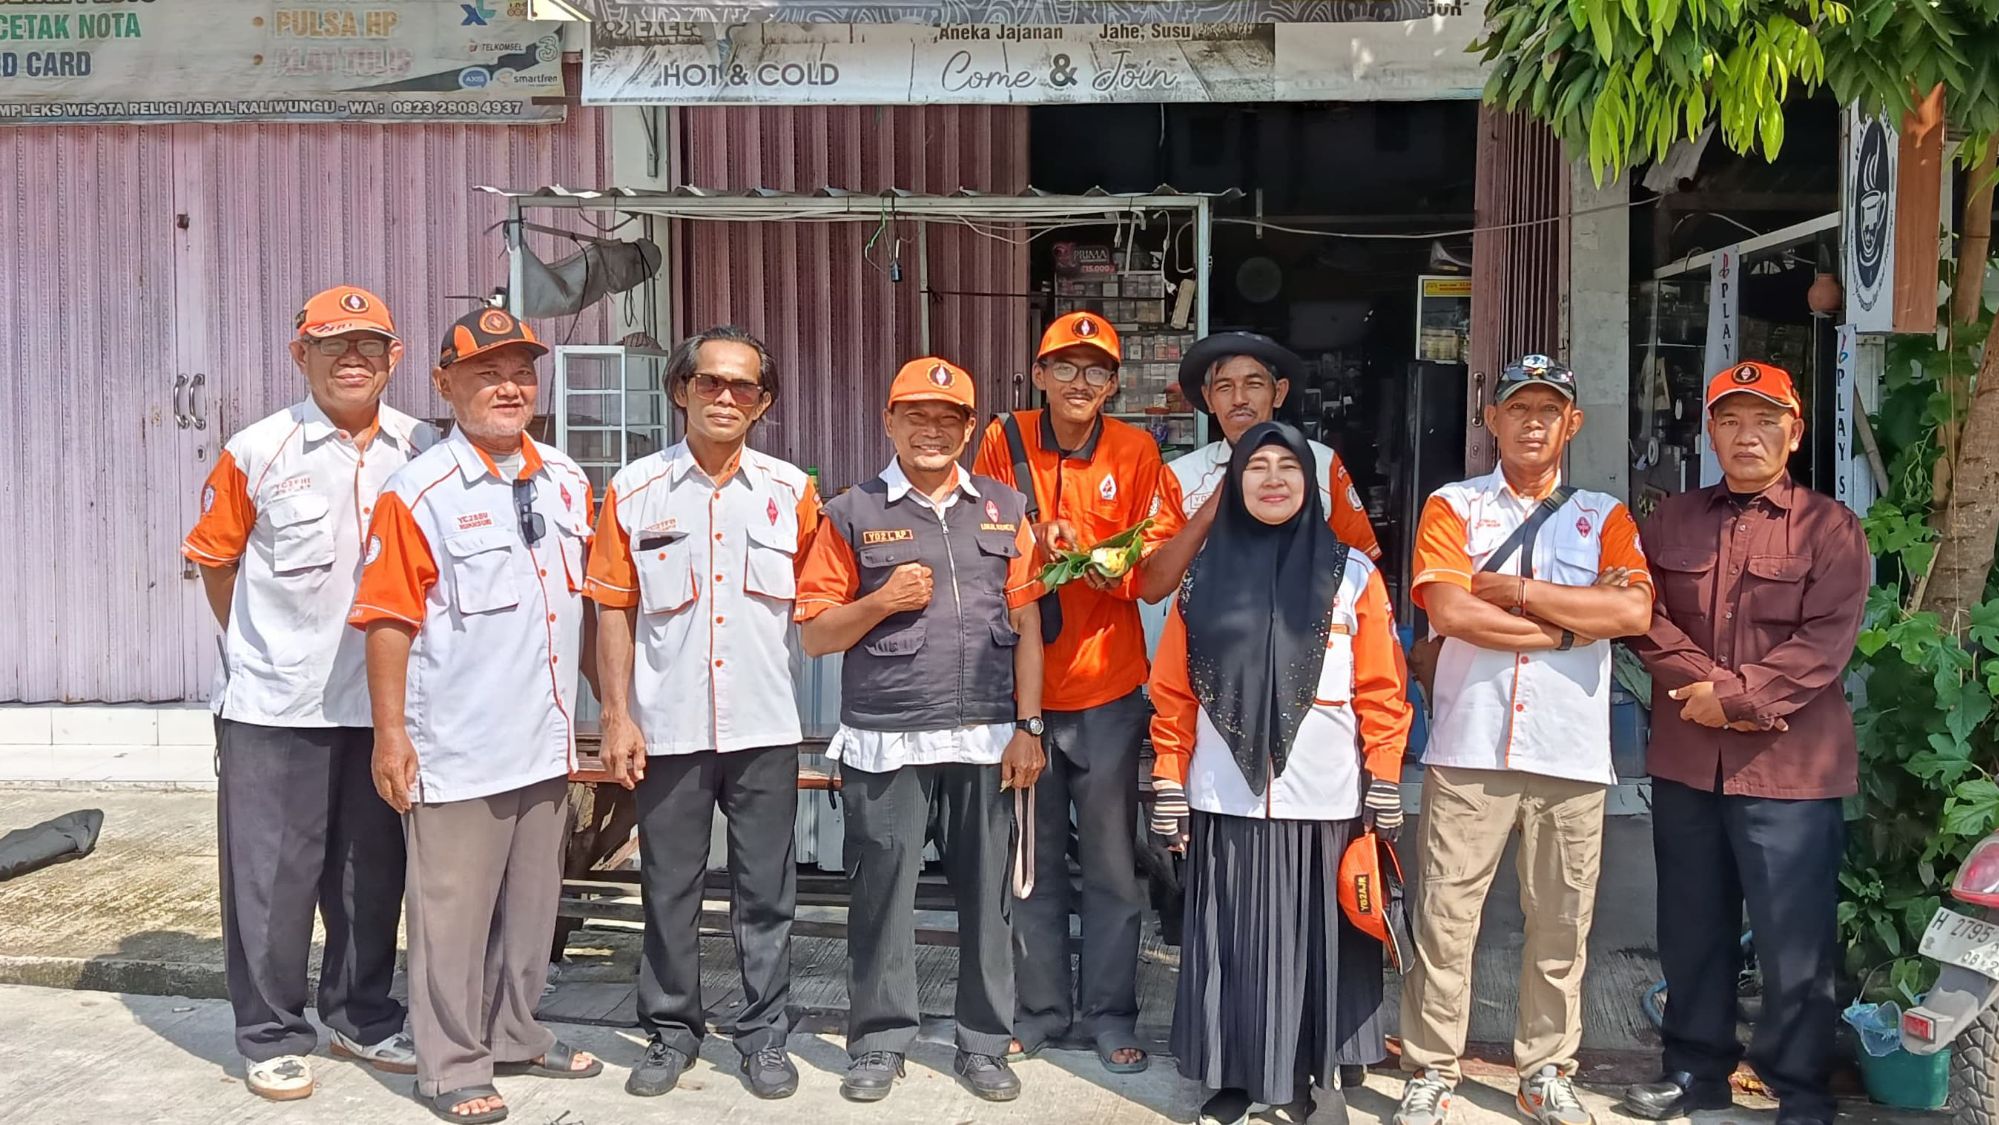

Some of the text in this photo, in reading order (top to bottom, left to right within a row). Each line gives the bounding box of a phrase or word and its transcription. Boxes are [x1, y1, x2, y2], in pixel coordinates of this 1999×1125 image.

[0, 13, 141, 40] CETAK NOTA
[276, 10, 399, 37] PULSA HP
[939, 25, 1063, 42] Aneka Jajanan
[1099, 24, 1191, 41] Jahe, Susu
[482, 43, 523, 51] TELKOMSEL
[27, 52, 91, 77] CARD
[663, 63, 839, 86] HOT & COLD
[942, 50, 1177, 92] Come & Join
[513, 74, 558, 84] smartfren
[66, 102, 126, 116] WISATA
[129, 102, 182, 115] RELIGI
[185, 101, 235, 115] JABAL
[237, 101, 337, 114] KALIWUNGU
[391, 101, 433, 114] 0823
[437, 101, 478, 114] 2808
[481, 101, 522, 114] 4937
[1932, 911, 1996, 943] H 2795
